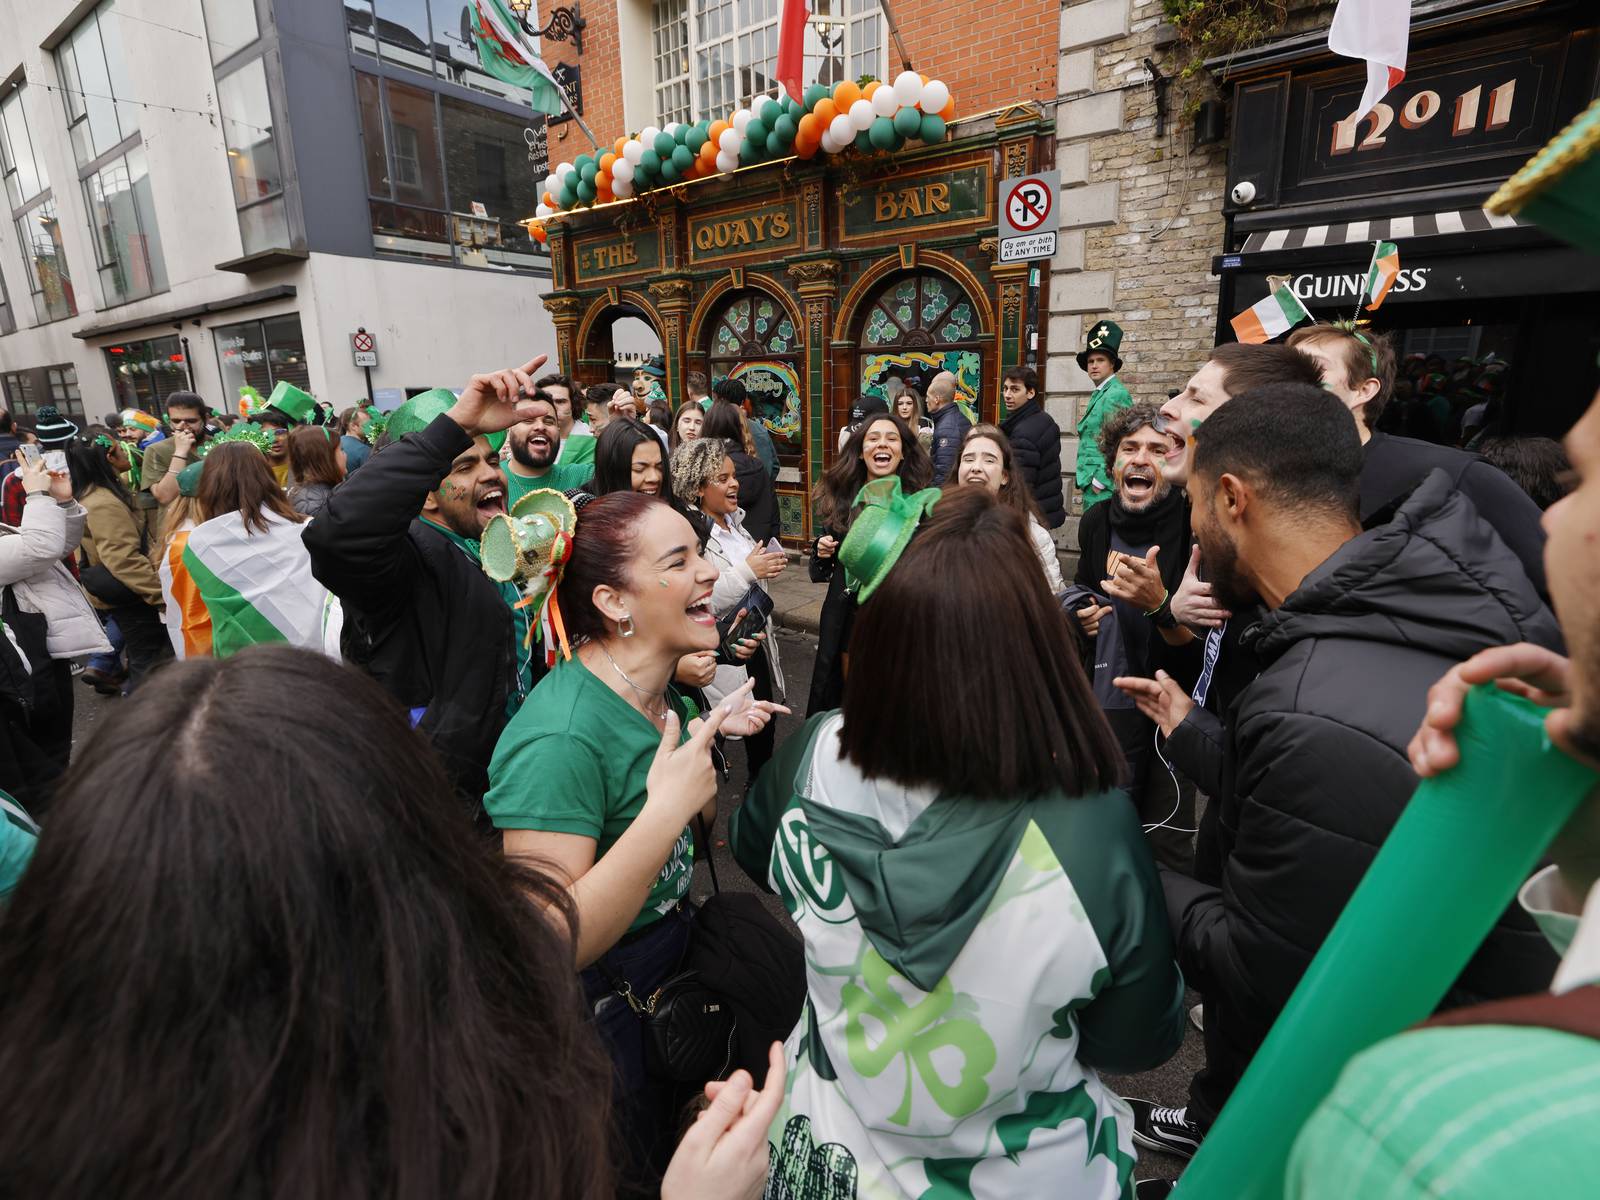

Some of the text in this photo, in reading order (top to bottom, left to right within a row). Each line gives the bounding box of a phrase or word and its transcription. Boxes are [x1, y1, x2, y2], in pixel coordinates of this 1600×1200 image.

[593, 242, 639, 270] THE
[875, 182, 950, 223] BAR
[1004, 244, 1052, 258] AT ANY TIME
[1038, 236, 1053, 245] bith
[1292, 267, 1428, 299] GUINSS
